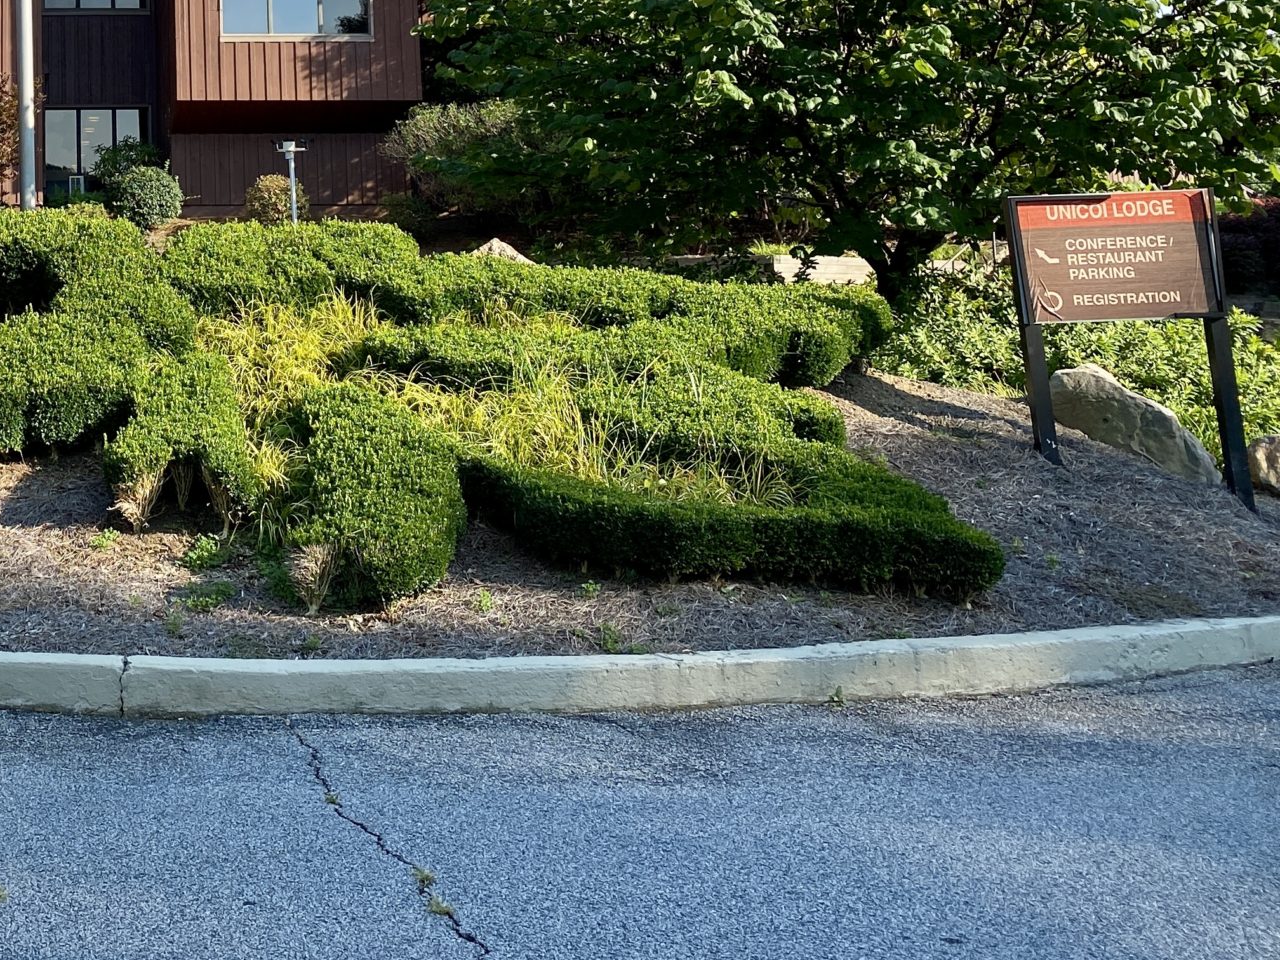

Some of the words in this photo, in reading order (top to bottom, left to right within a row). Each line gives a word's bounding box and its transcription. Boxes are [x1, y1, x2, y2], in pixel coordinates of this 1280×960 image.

[1045, 204, 1108, 221] UNICOI
[1113, 199, 1176, 218] LODGE
[1065, 235, 1168, 251] CONFERENCE
[1067, 250, 1165, 266] RESTAURANT
[1069, 266, 1136, 281] PARKING
[1073, 290, 1181, 306] REGISTRATION
